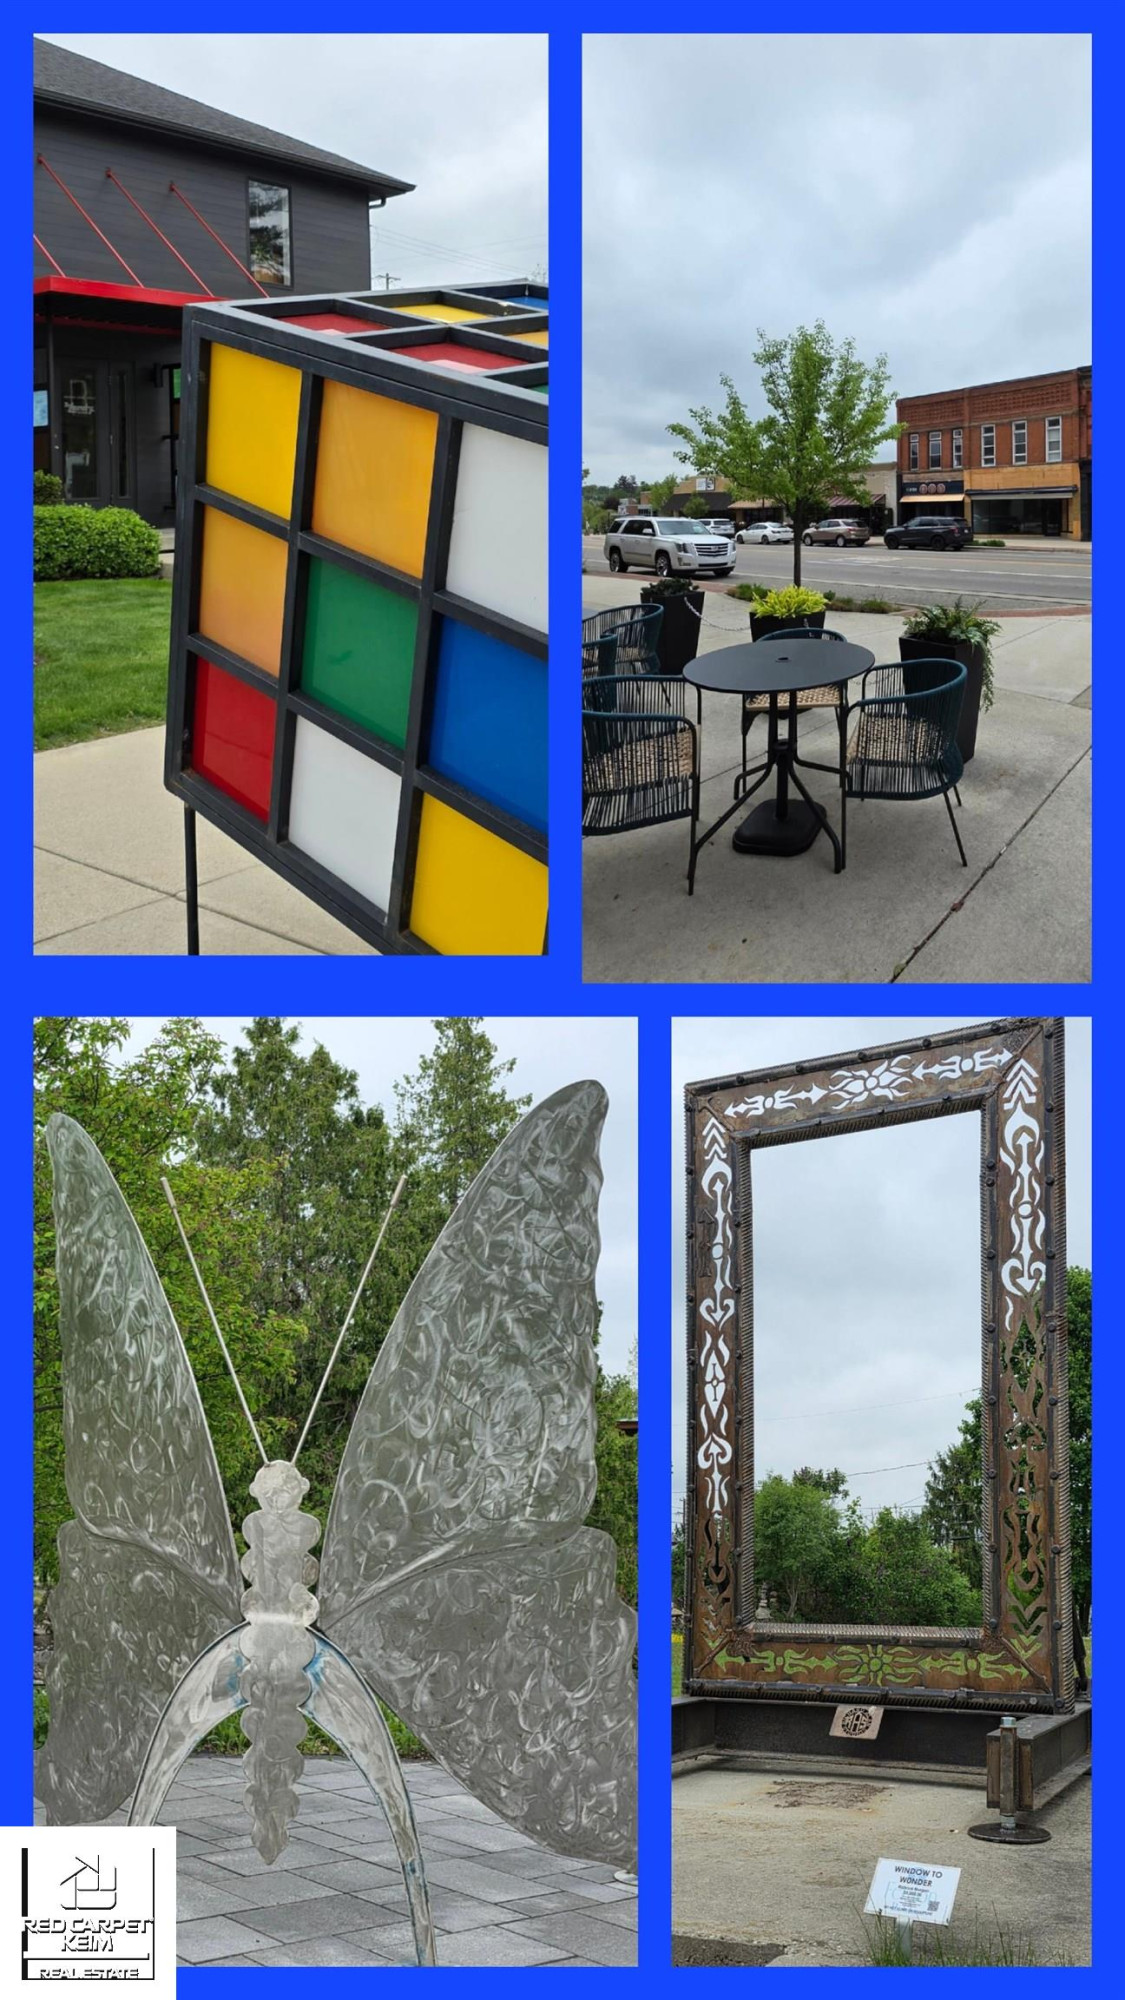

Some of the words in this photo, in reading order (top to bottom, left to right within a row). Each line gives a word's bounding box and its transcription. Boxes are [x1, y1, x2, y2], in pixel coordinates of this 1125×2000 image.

[894, 1865, 930, 1877] WINDOW
[931, 1870, 943, 1879] TO
[899, 1876, 933, 1887] WONDER
